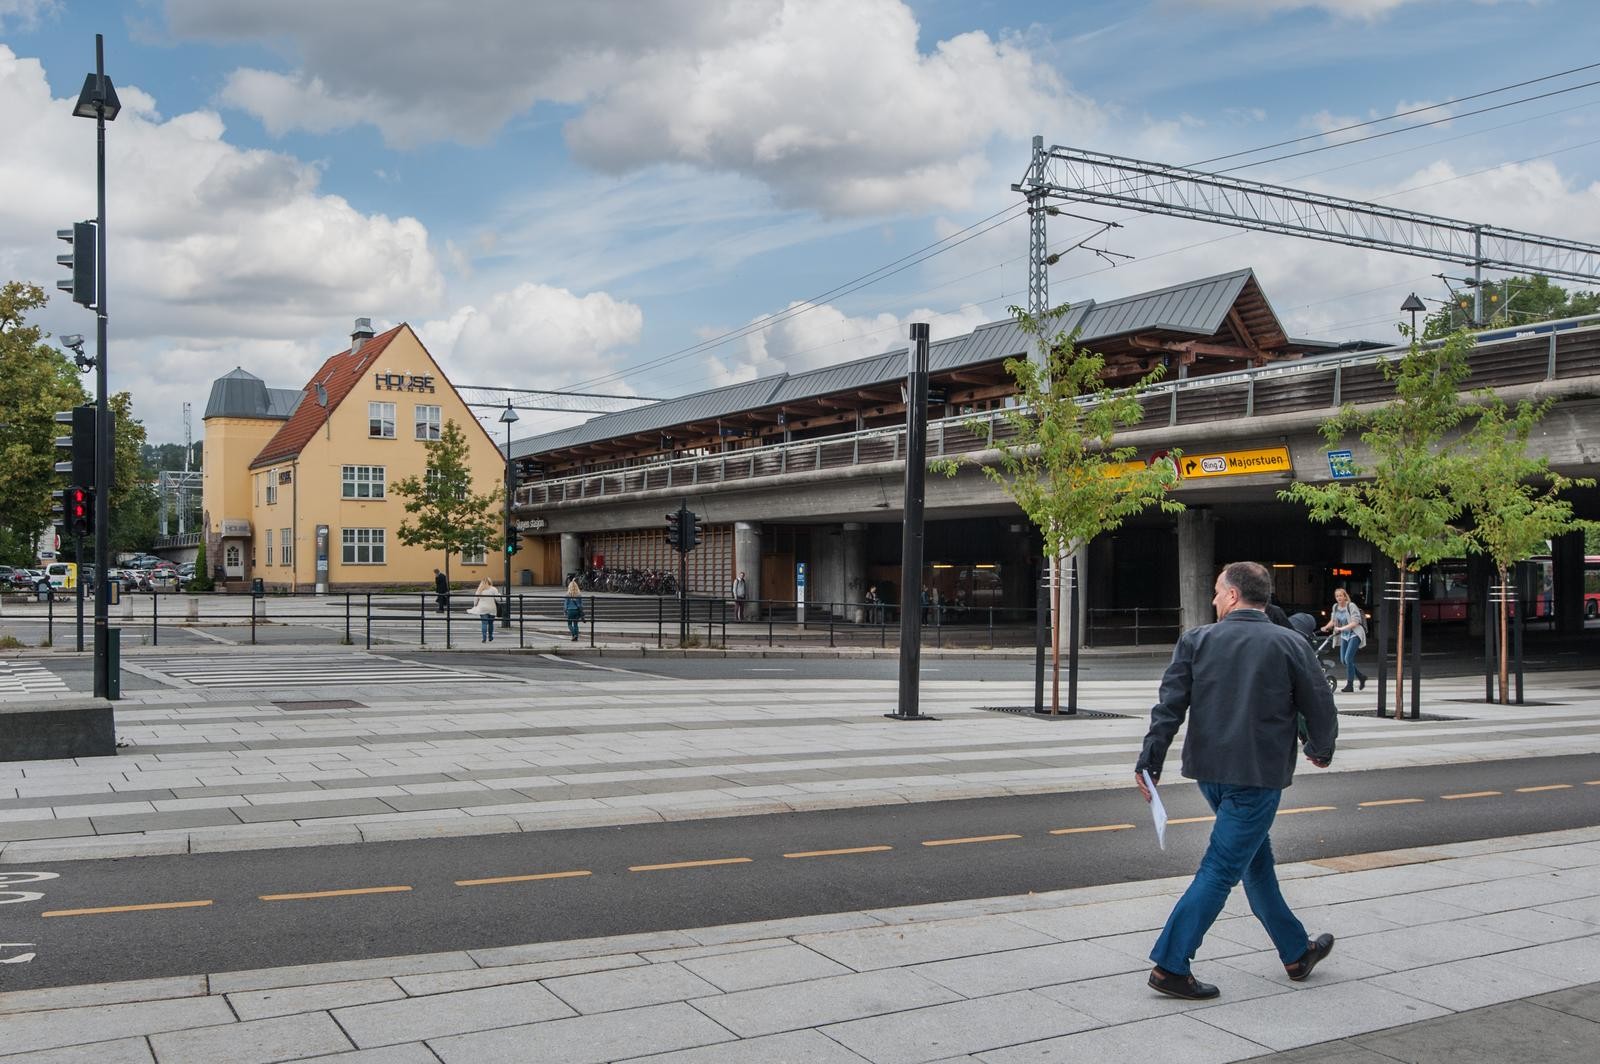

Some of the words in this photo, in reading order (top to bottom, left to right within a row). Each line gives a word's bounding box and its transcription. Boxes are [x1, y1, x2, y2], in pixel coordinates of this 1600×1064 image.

[376, 373, 435, 389] HOUSE
[376, 384, 435, 394] BRANDS
[1203, 462, 1218, 470] Ring
[1219, 460, 1224, 469] 2
[1229, 455, 1284, 469] Majorstuen
